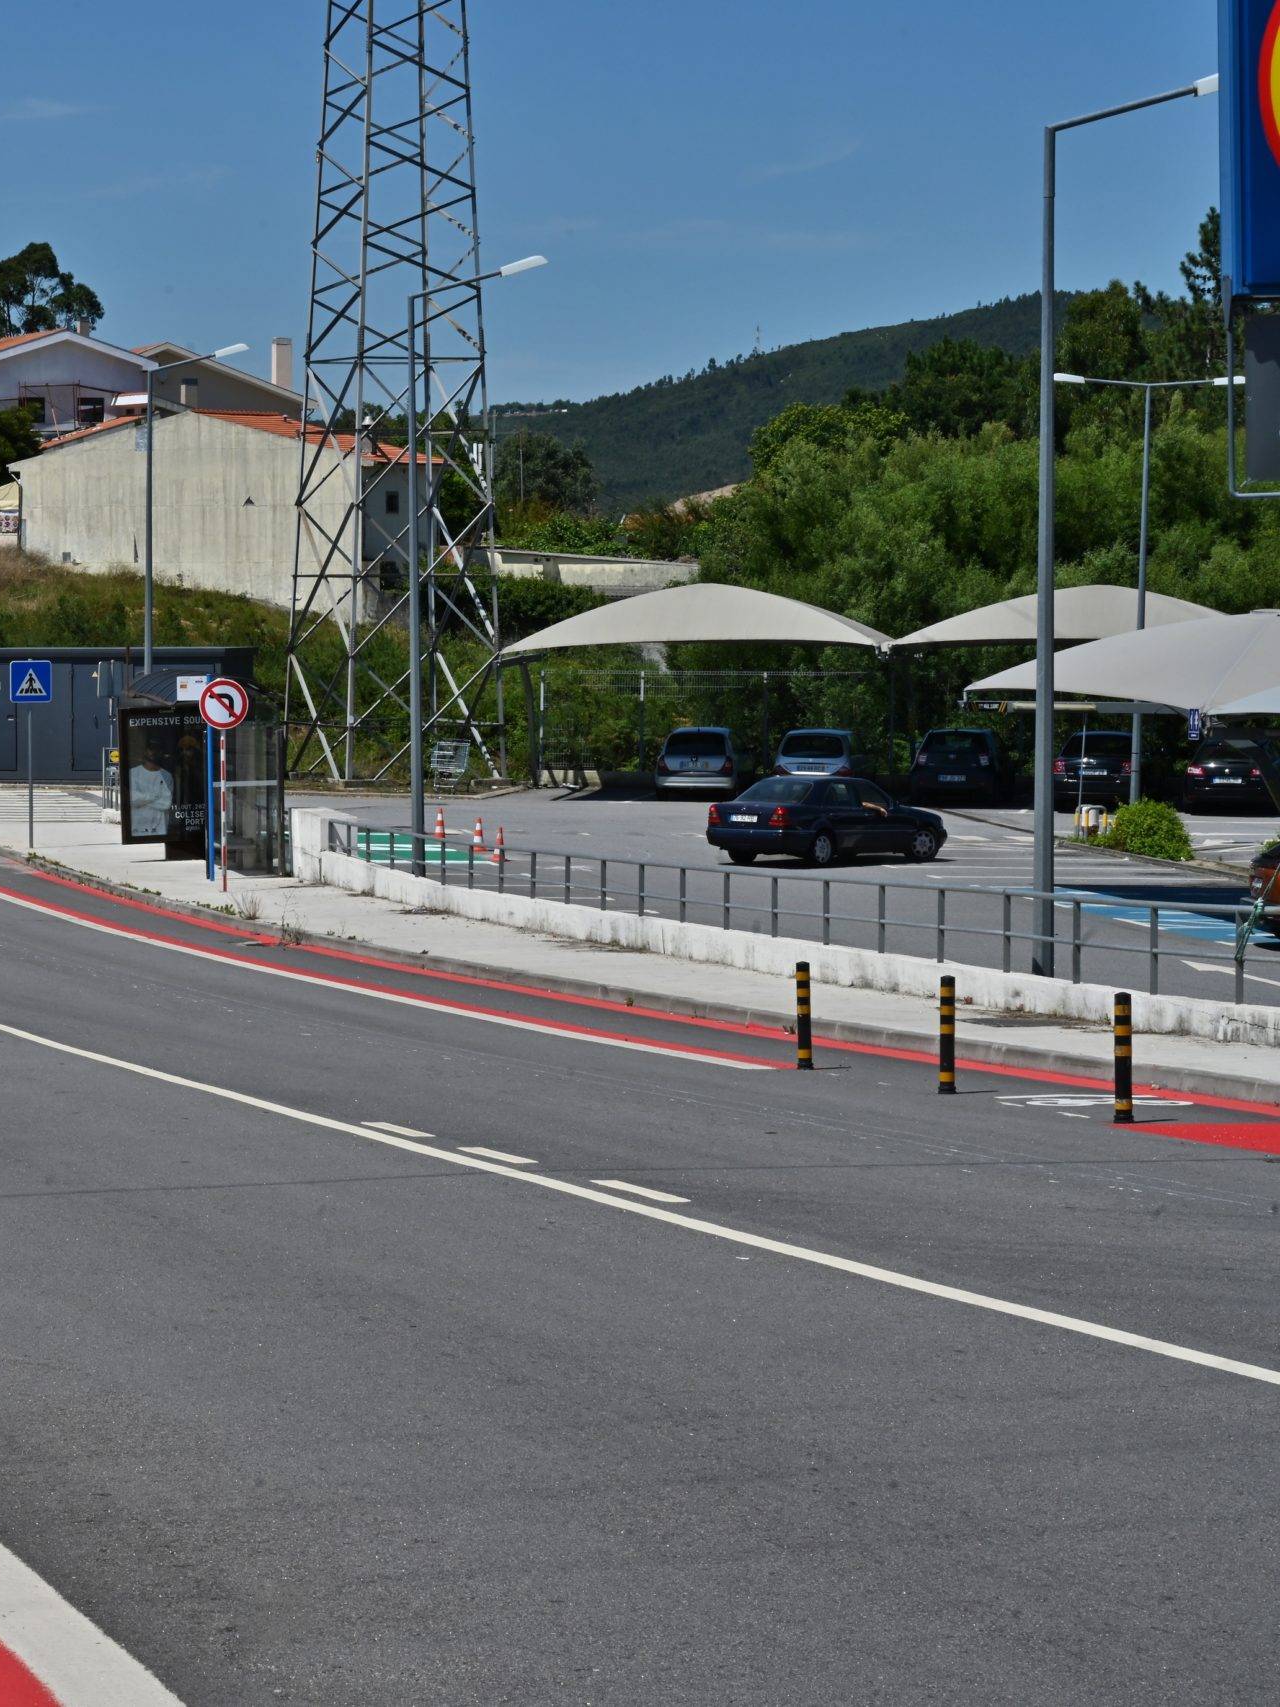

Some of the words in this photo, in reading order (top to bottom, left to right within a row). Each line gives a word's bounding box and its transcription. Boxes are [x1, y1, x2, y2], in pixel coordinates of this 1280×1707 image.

[129, 716, 181, 727] EXPENSIVE
[175, 810, 205, 819] COLISE
[185, 818, 204, 826] PORT
